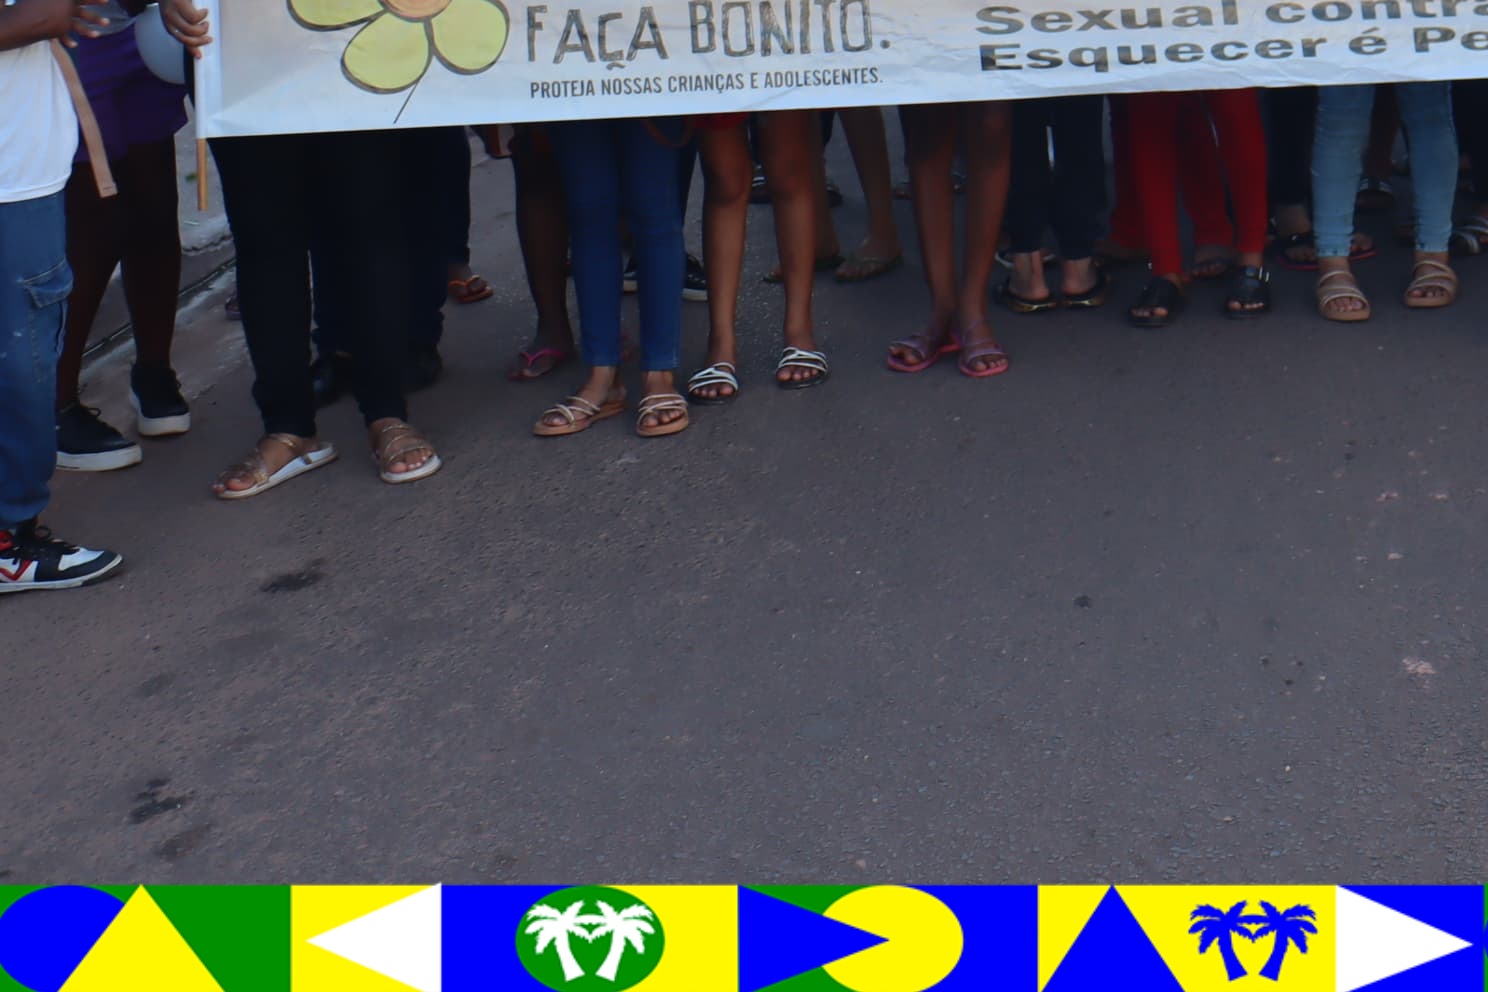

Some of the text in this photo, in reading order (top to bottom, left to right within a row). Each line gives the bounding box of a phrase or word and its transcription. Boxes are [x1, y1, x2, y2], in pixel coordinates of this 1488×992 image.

[527, 4, 669, 70] FAÇA
[979, 34, 1328, 73] Esquecer
[1348, 26, 1389, 56] é
[530, 66, 884, 99] PROTEJA NOSSAS CRIANÇAS E ADOLESCENTES.
